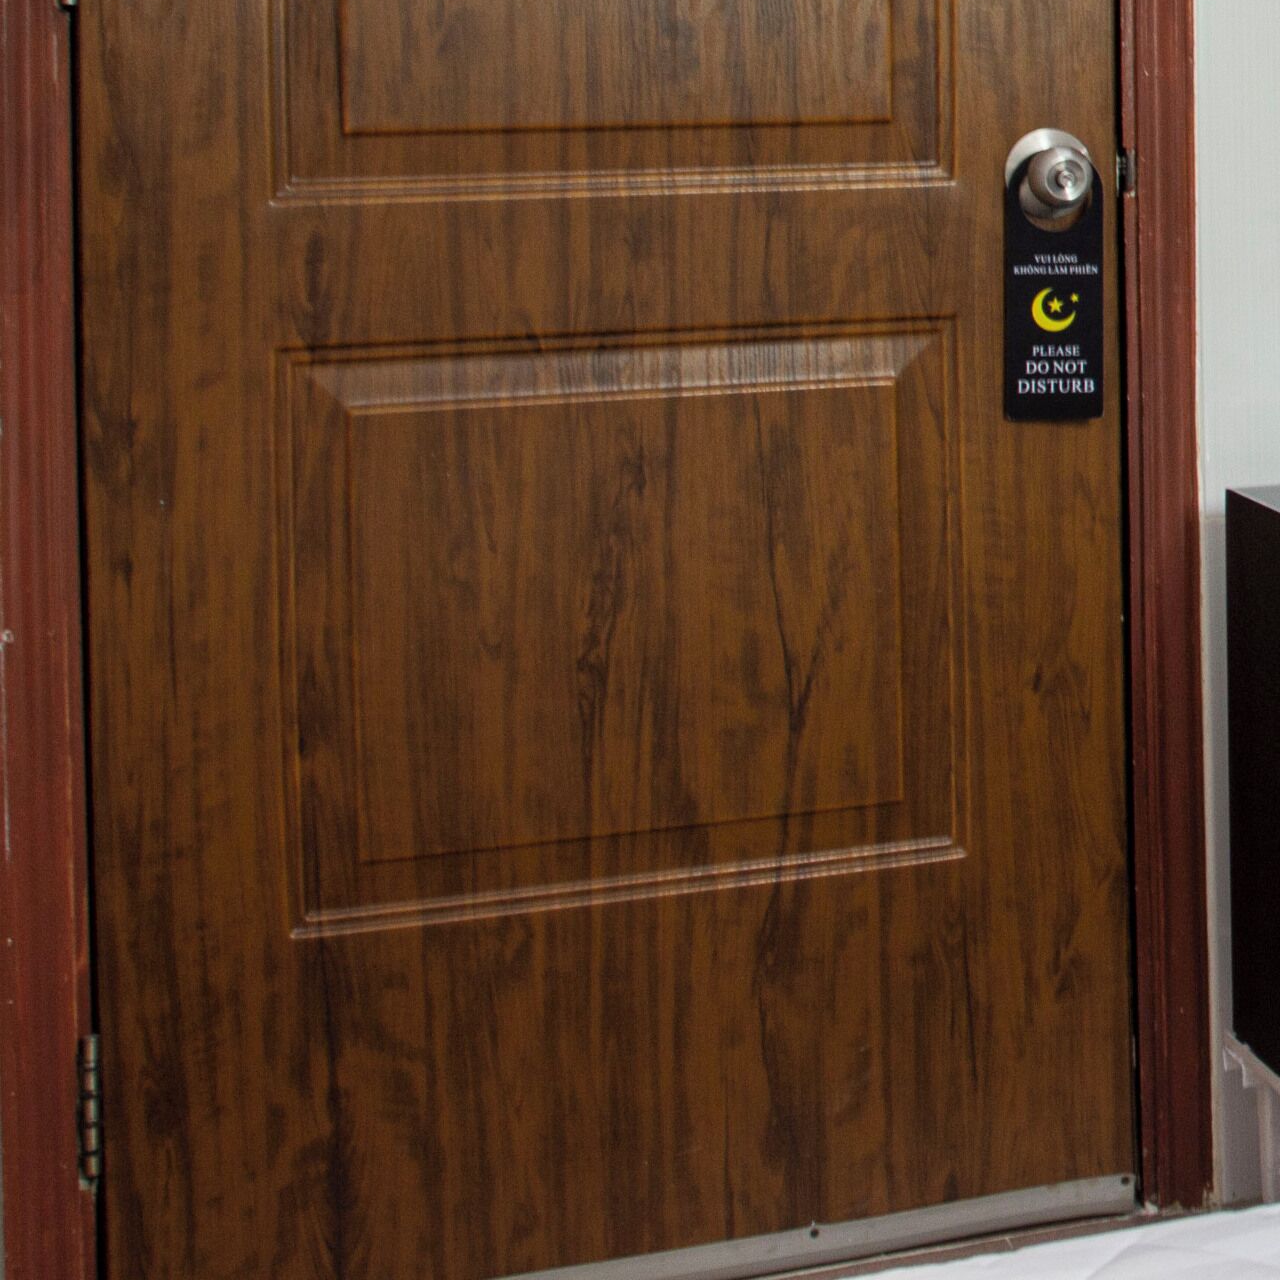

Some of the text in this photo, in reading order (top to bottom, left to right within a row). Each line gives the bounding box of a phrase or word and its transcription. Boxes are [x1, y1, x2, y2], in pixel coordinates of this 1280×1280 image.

[1034, 252, 1078, 263] VUI LÒNG
[1013, 264, 1047, 275] KHÔNG
[1048, 264, 1068, 275] LÀM
[1032, 345, 1080, 357] PLEASE
[1025, 360, 1087, 375] DO NOT
[1018, 378, 1095, 394] DISTURB
